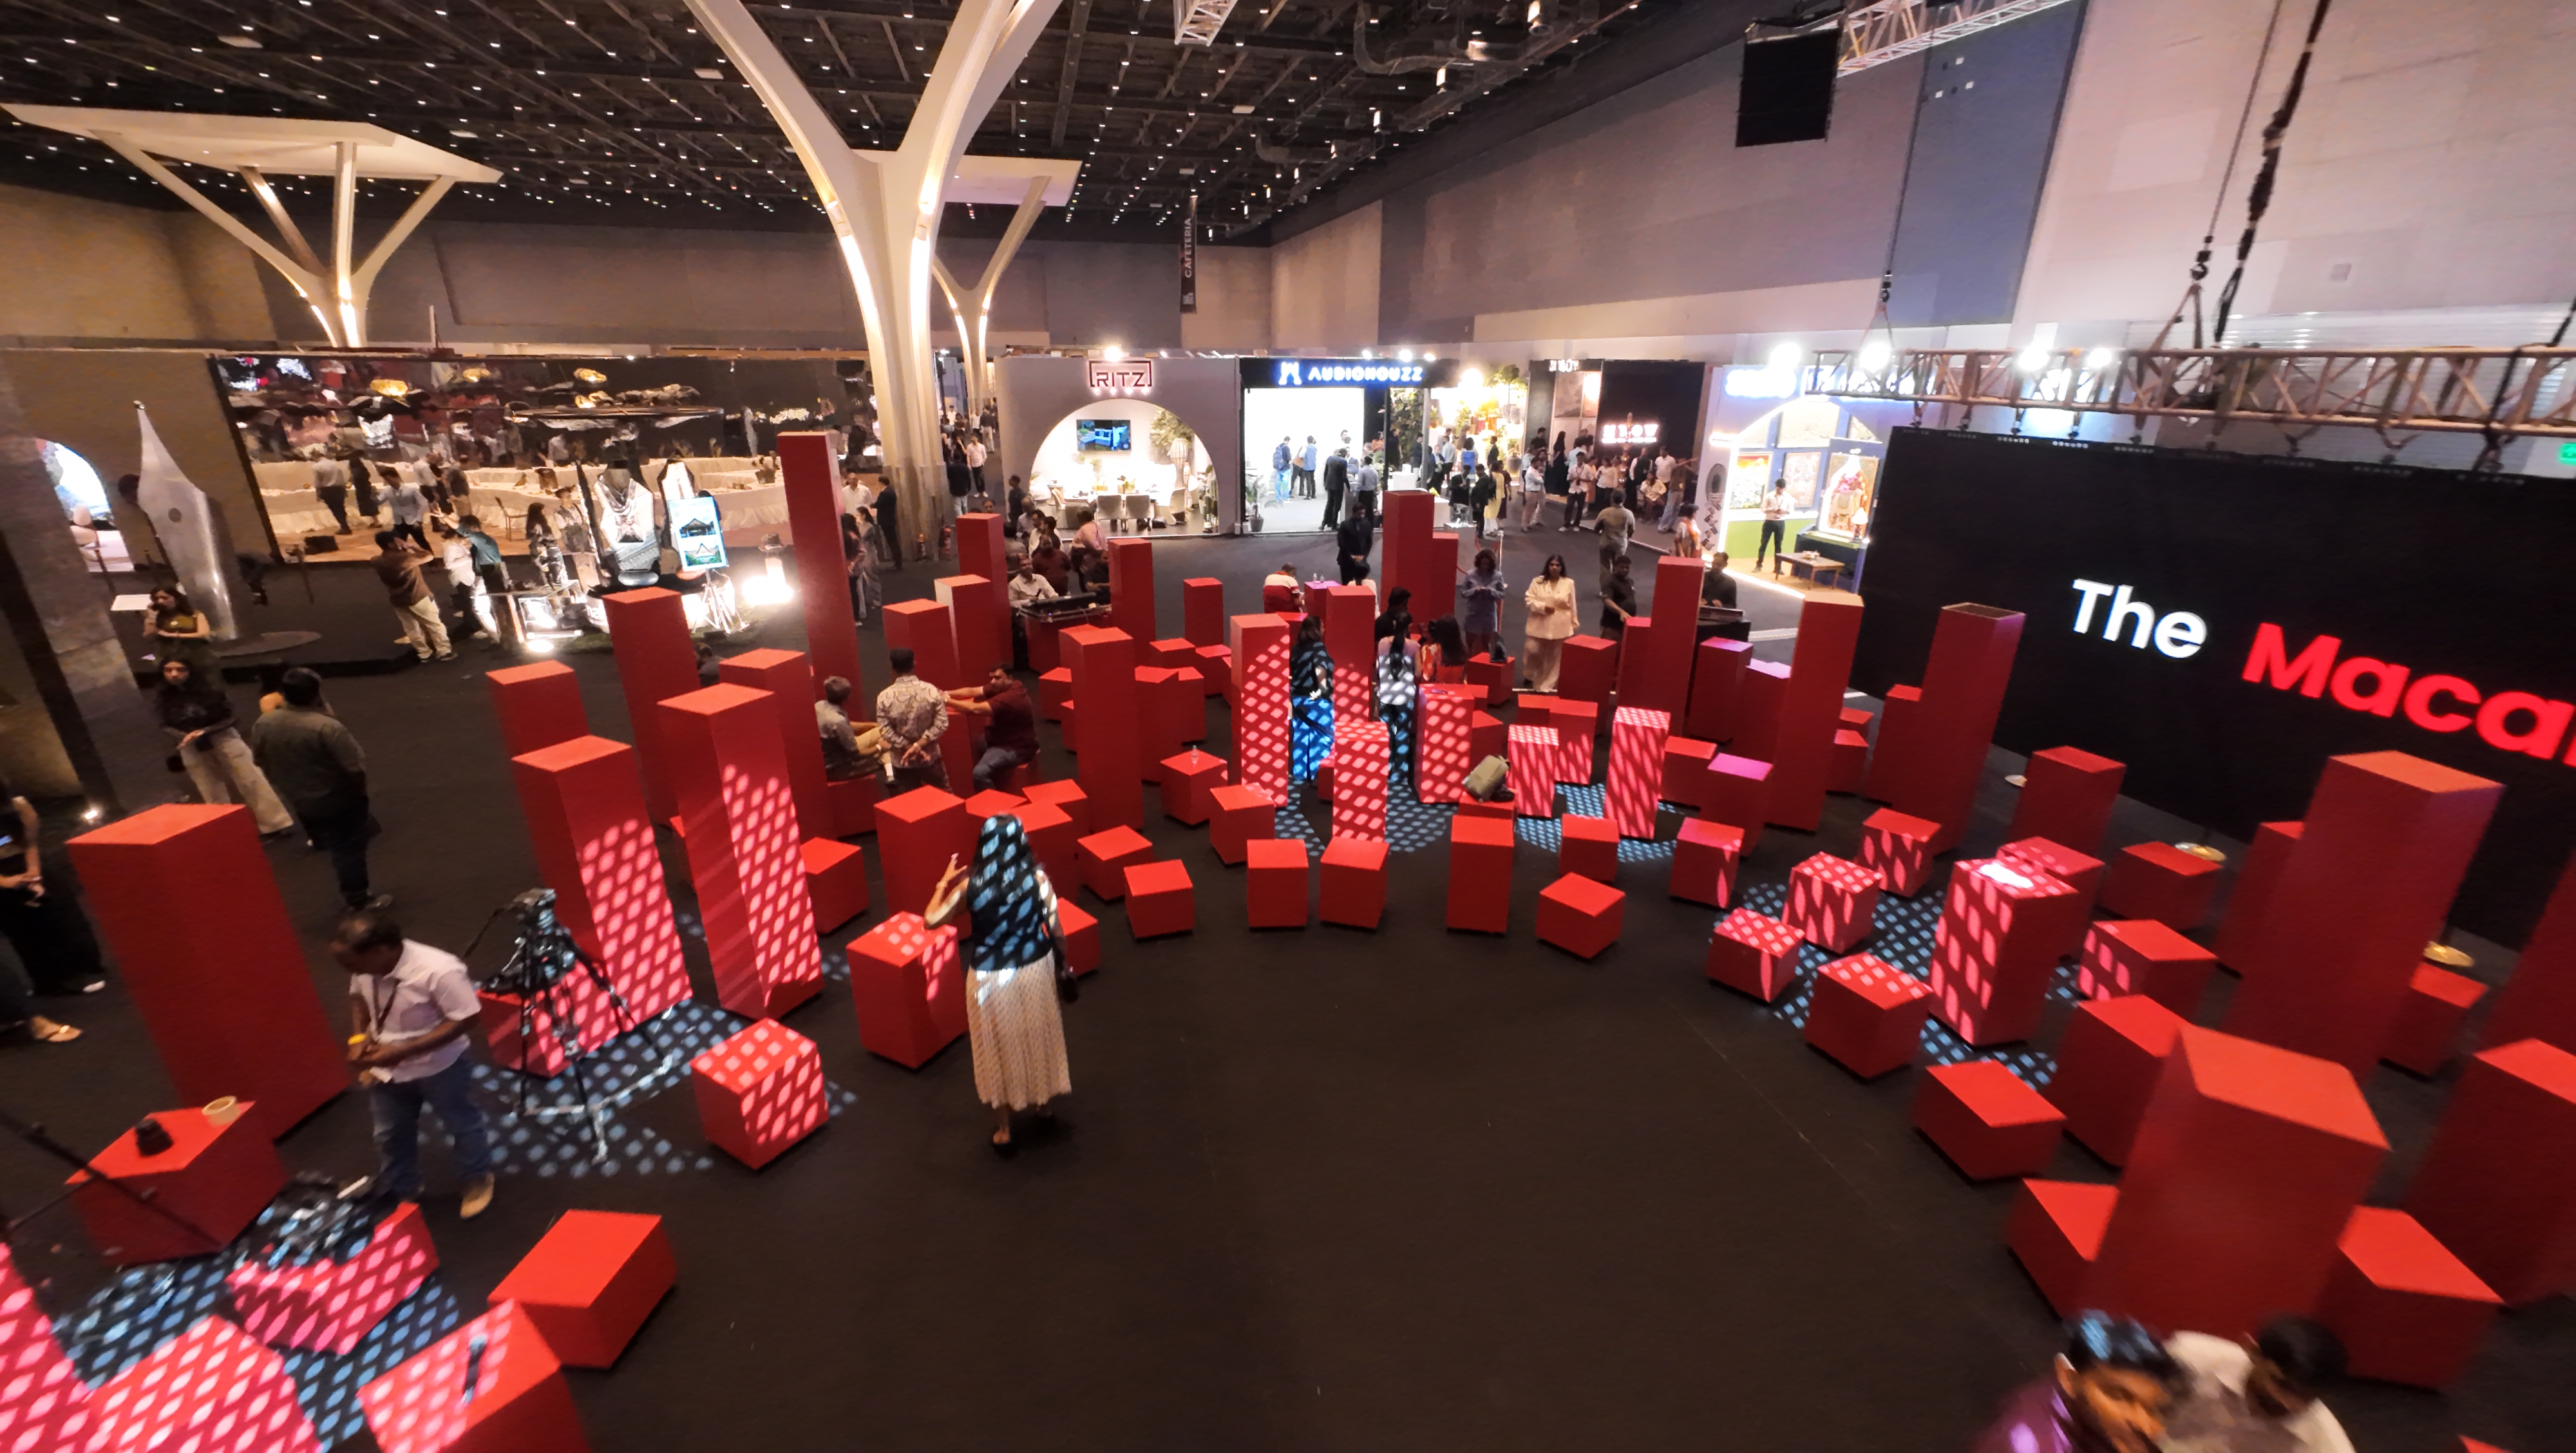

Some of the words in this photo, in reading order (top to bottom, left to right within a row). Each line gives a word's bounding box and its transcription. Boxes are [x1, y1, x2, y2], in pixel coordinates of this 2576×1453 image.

[1096, 372, 1146, 387] RITZ
[1307, 366, 1424, 382] AUDIOHOUZZ
[2071, 577, 2208, 659] The
[2242, 622, 2576, 768] Maca
